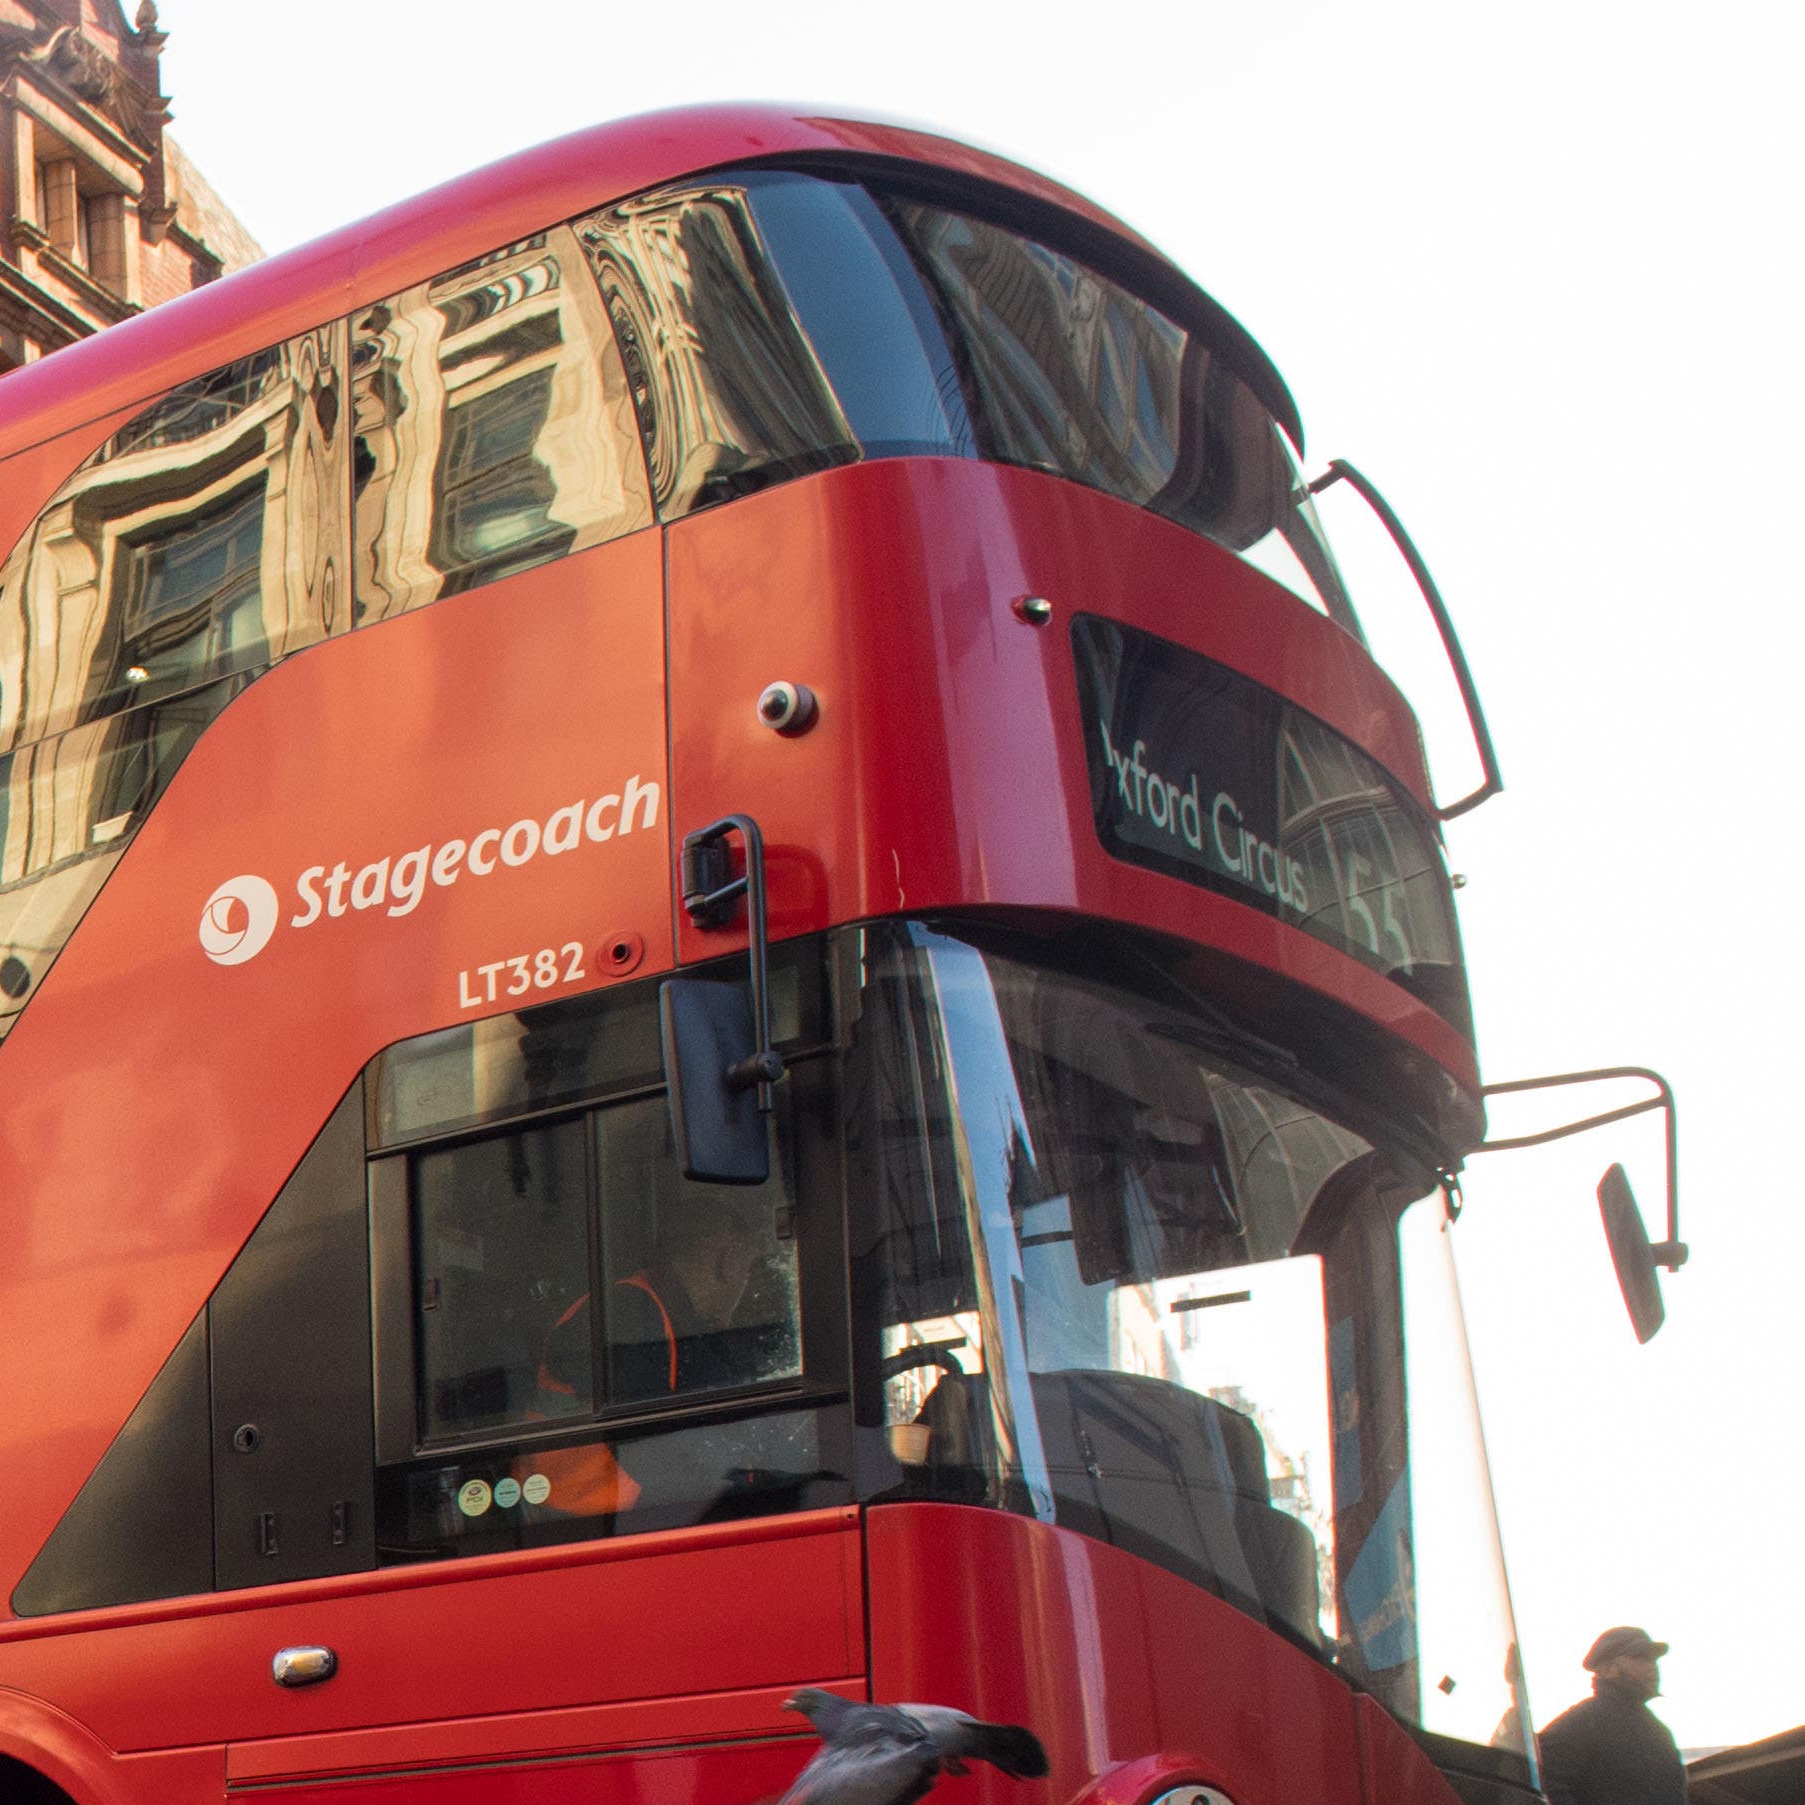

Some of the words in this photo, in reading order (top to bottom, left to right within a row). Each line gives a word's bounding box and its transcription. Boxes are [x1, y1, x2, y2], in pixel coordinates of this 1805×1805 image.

[290, 774, 661, 929] Stagecoach
[1100, 718, 1202, 850] xford
[1212, 791, 1307, 912] Circus
[1348, 850, 1413, 976] 55
[458, 941, 586, 1009] LT382
